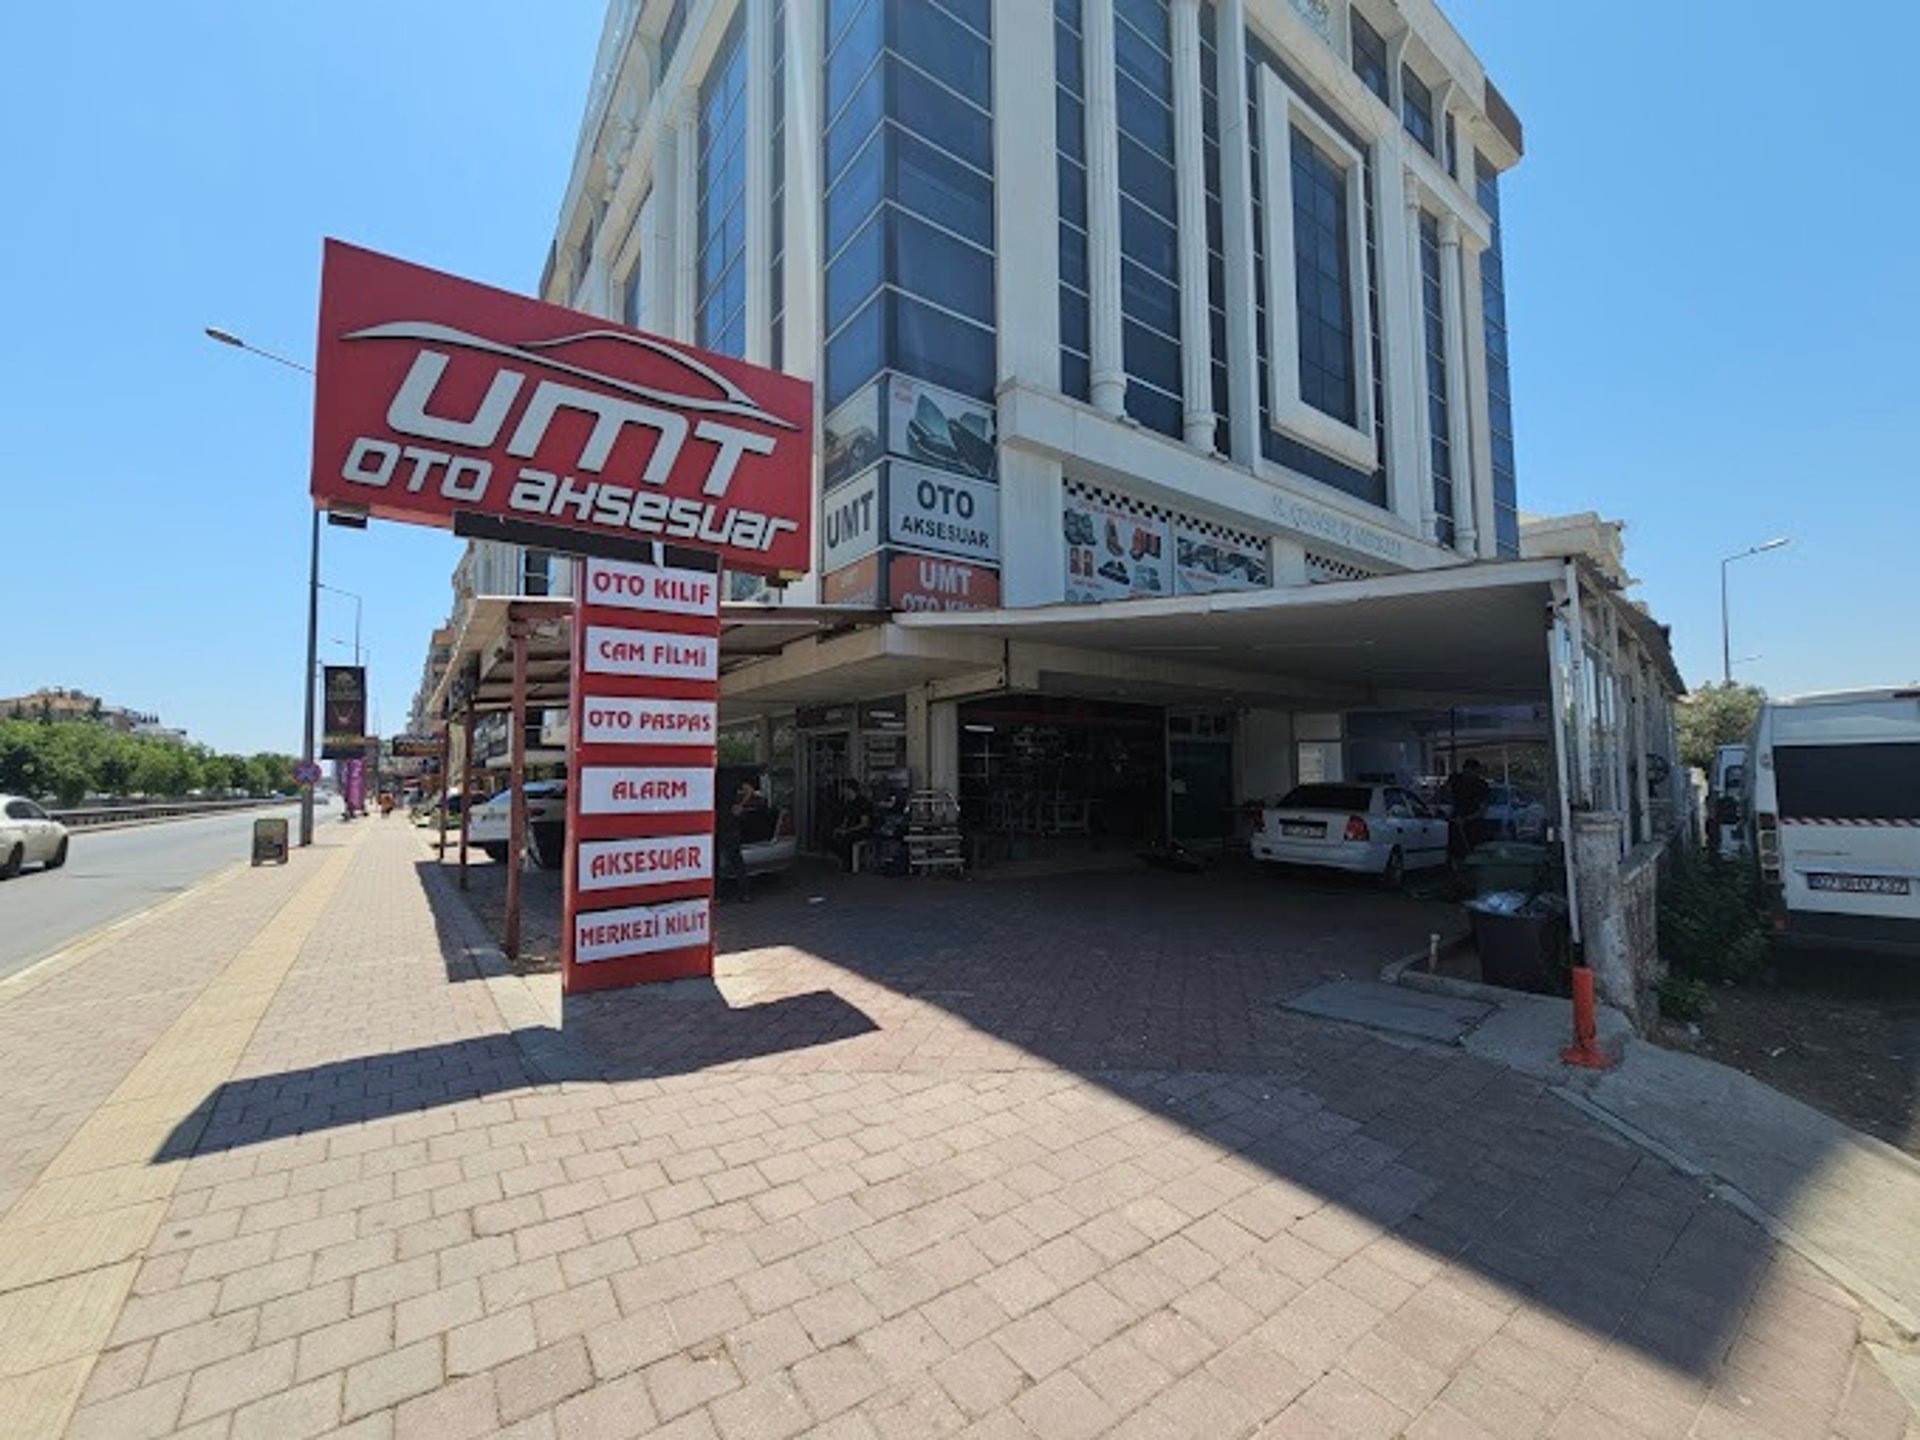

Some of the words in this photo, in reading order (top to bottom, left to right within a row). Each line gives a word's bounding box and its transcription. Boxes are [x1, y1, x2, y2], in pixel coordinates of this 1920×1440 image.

[387, 350, 776, 498] UMT
[342, 438, 494, 502] OTO
[917, 480, 974, 518] OTO
[827, 491, 873, 548] UMT
[901, 516, 990, 548] AKSESUAR
[592, 571, 645, 597] OTO
[654, 578, 710, 605] KILIF
[920, 560, 972, 595] UMT
[599, 641, 645, 661] CAM
[588, 711, 632, 729] OTO
[640, 712, 711, 732] PASPAS
[612, 780, 687, 800] ALARM
[590, 846, 701, 879] AKSESUAR
[580, 914, 660, 947] MERKEZİ
[665, 909, 707, 935] KİLİT
